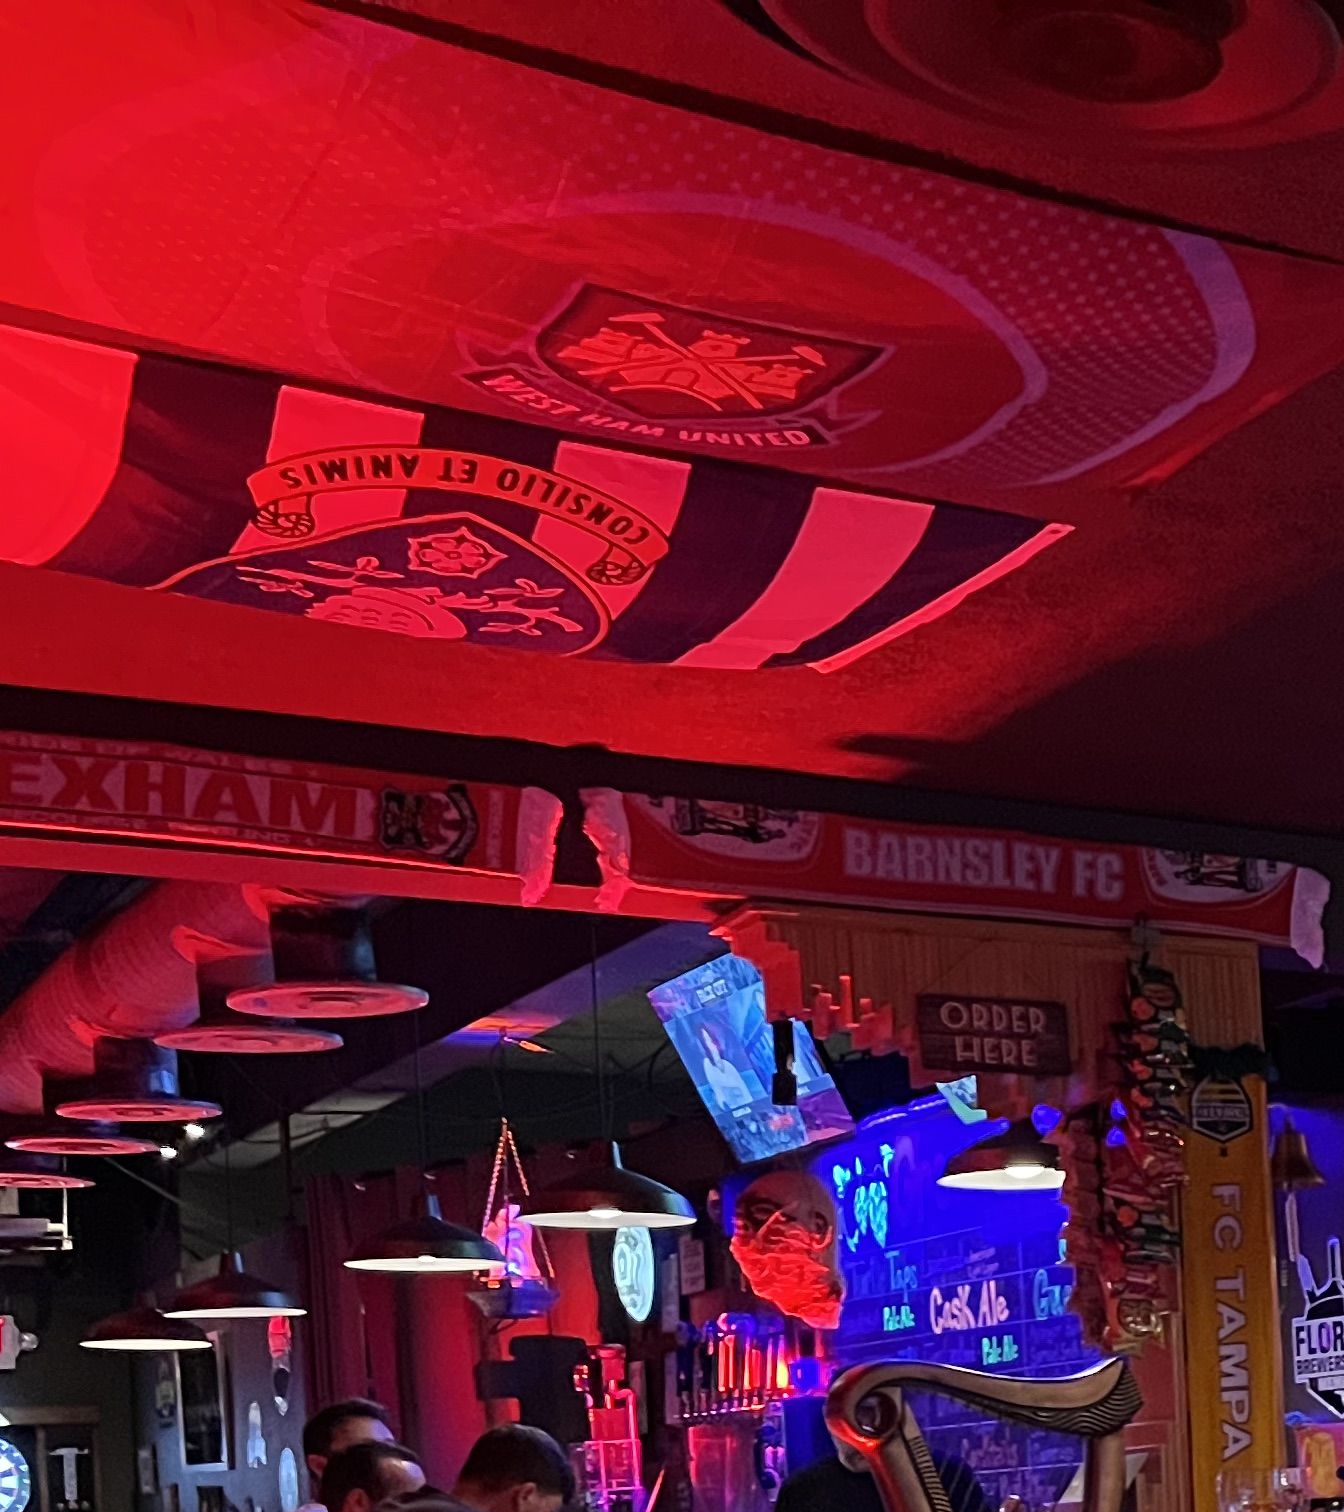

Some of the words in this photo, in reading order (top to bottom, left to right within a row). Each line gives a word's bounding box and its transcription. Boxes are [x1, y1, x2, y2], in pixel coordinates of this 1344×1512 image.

[483, 375, 580, 415] WEST
[579, 413, 665, 438] HAM
[678, 430, 812, 447] UNITED
[280, 453, 420, 490] ANIMIS
[437, 456, 478, 484] ET
[495, 474, 651, 546] CONSILIO
[0, 752, 357, 837] EXHAM
[843, 826, 1063, 894] BARNSLEY
[1071, 850, 1125, 901] FC
[939, 1001, 1046, 1033] ORDER
[954, 1035, 1038, 1066] HERE
[1211, 1184, 1243, 1250] FC
[977, 1280, 1010, 1328] Ale
[1214, 1267, 1253, 1462] TAMPA
